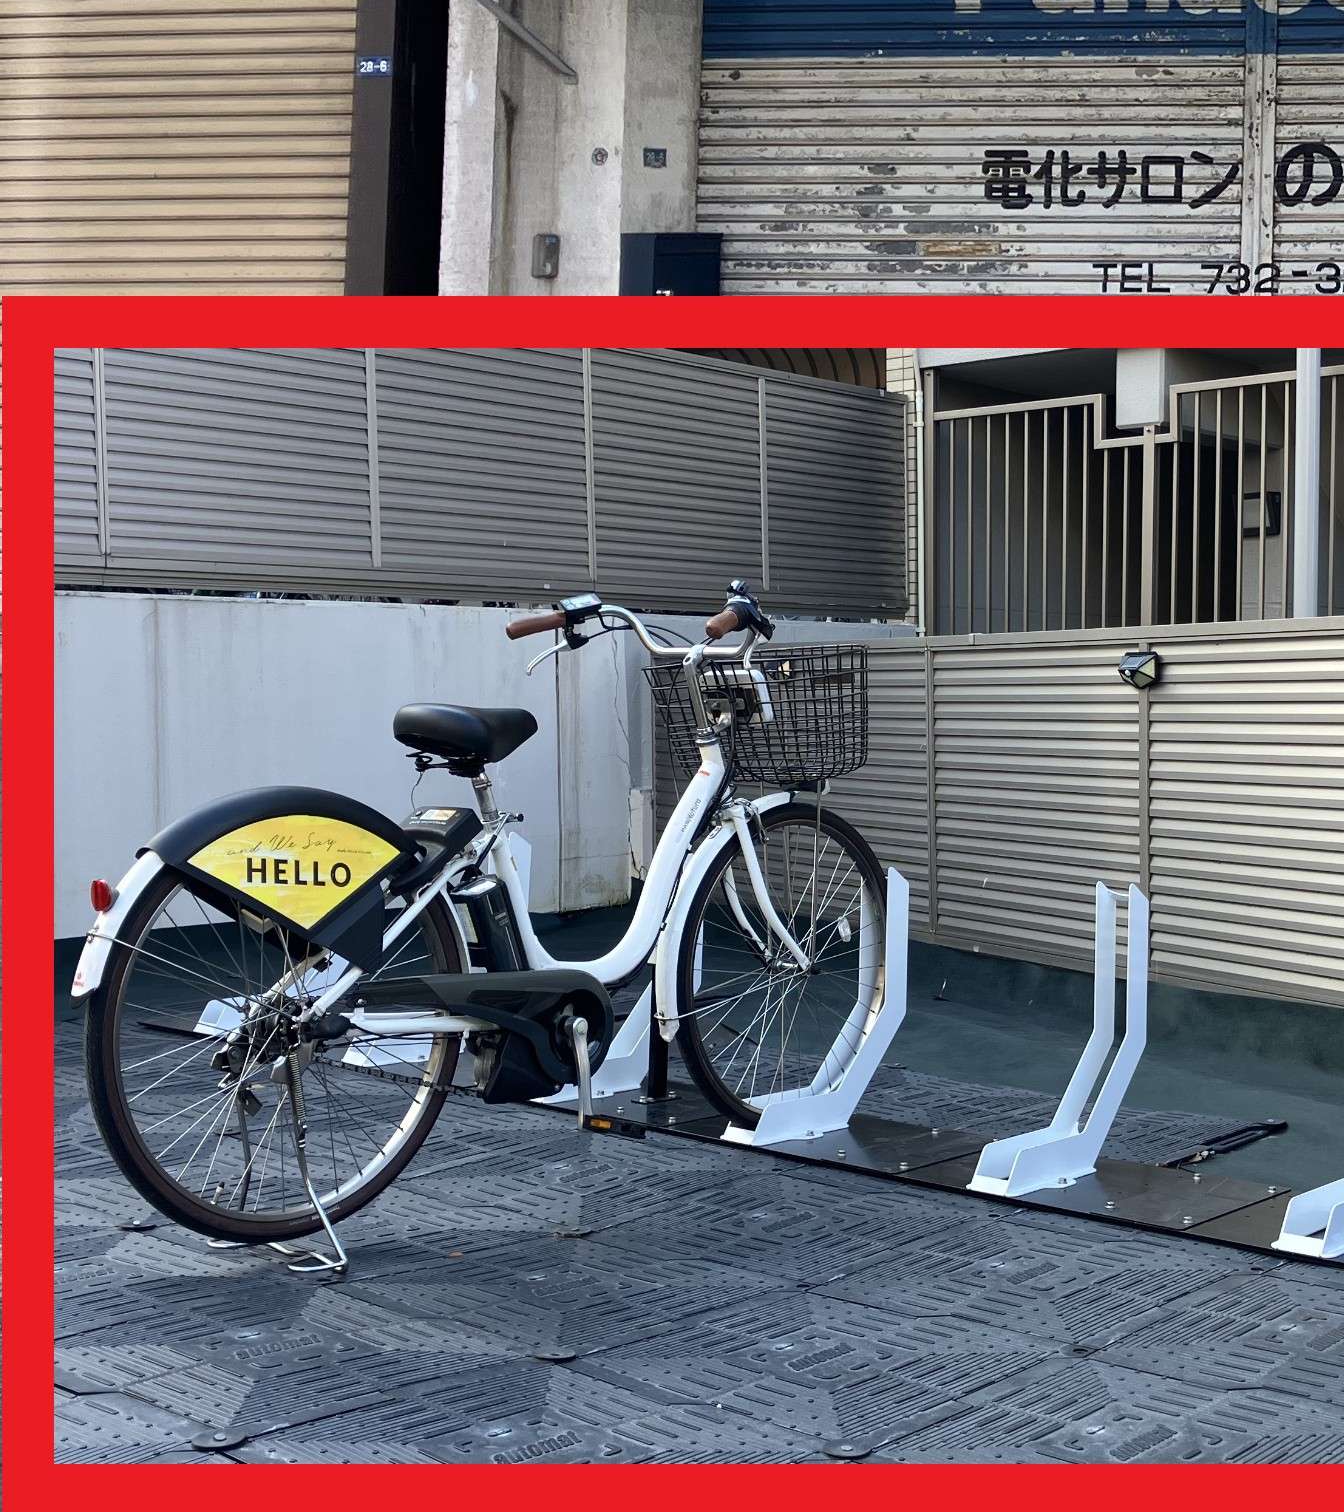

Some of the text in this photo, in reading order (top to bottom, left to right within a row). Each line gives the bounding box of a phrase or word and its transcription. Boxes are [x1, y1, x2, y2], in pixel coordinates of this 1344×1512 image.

[981, 147, 1241, 211] 電化サロン
[1092, 263, 1170, 294] TEL
[269, 834, 296, 851] We
[301, 832, 337, 852] Say
[246, 857, 352, 888] HELLO
